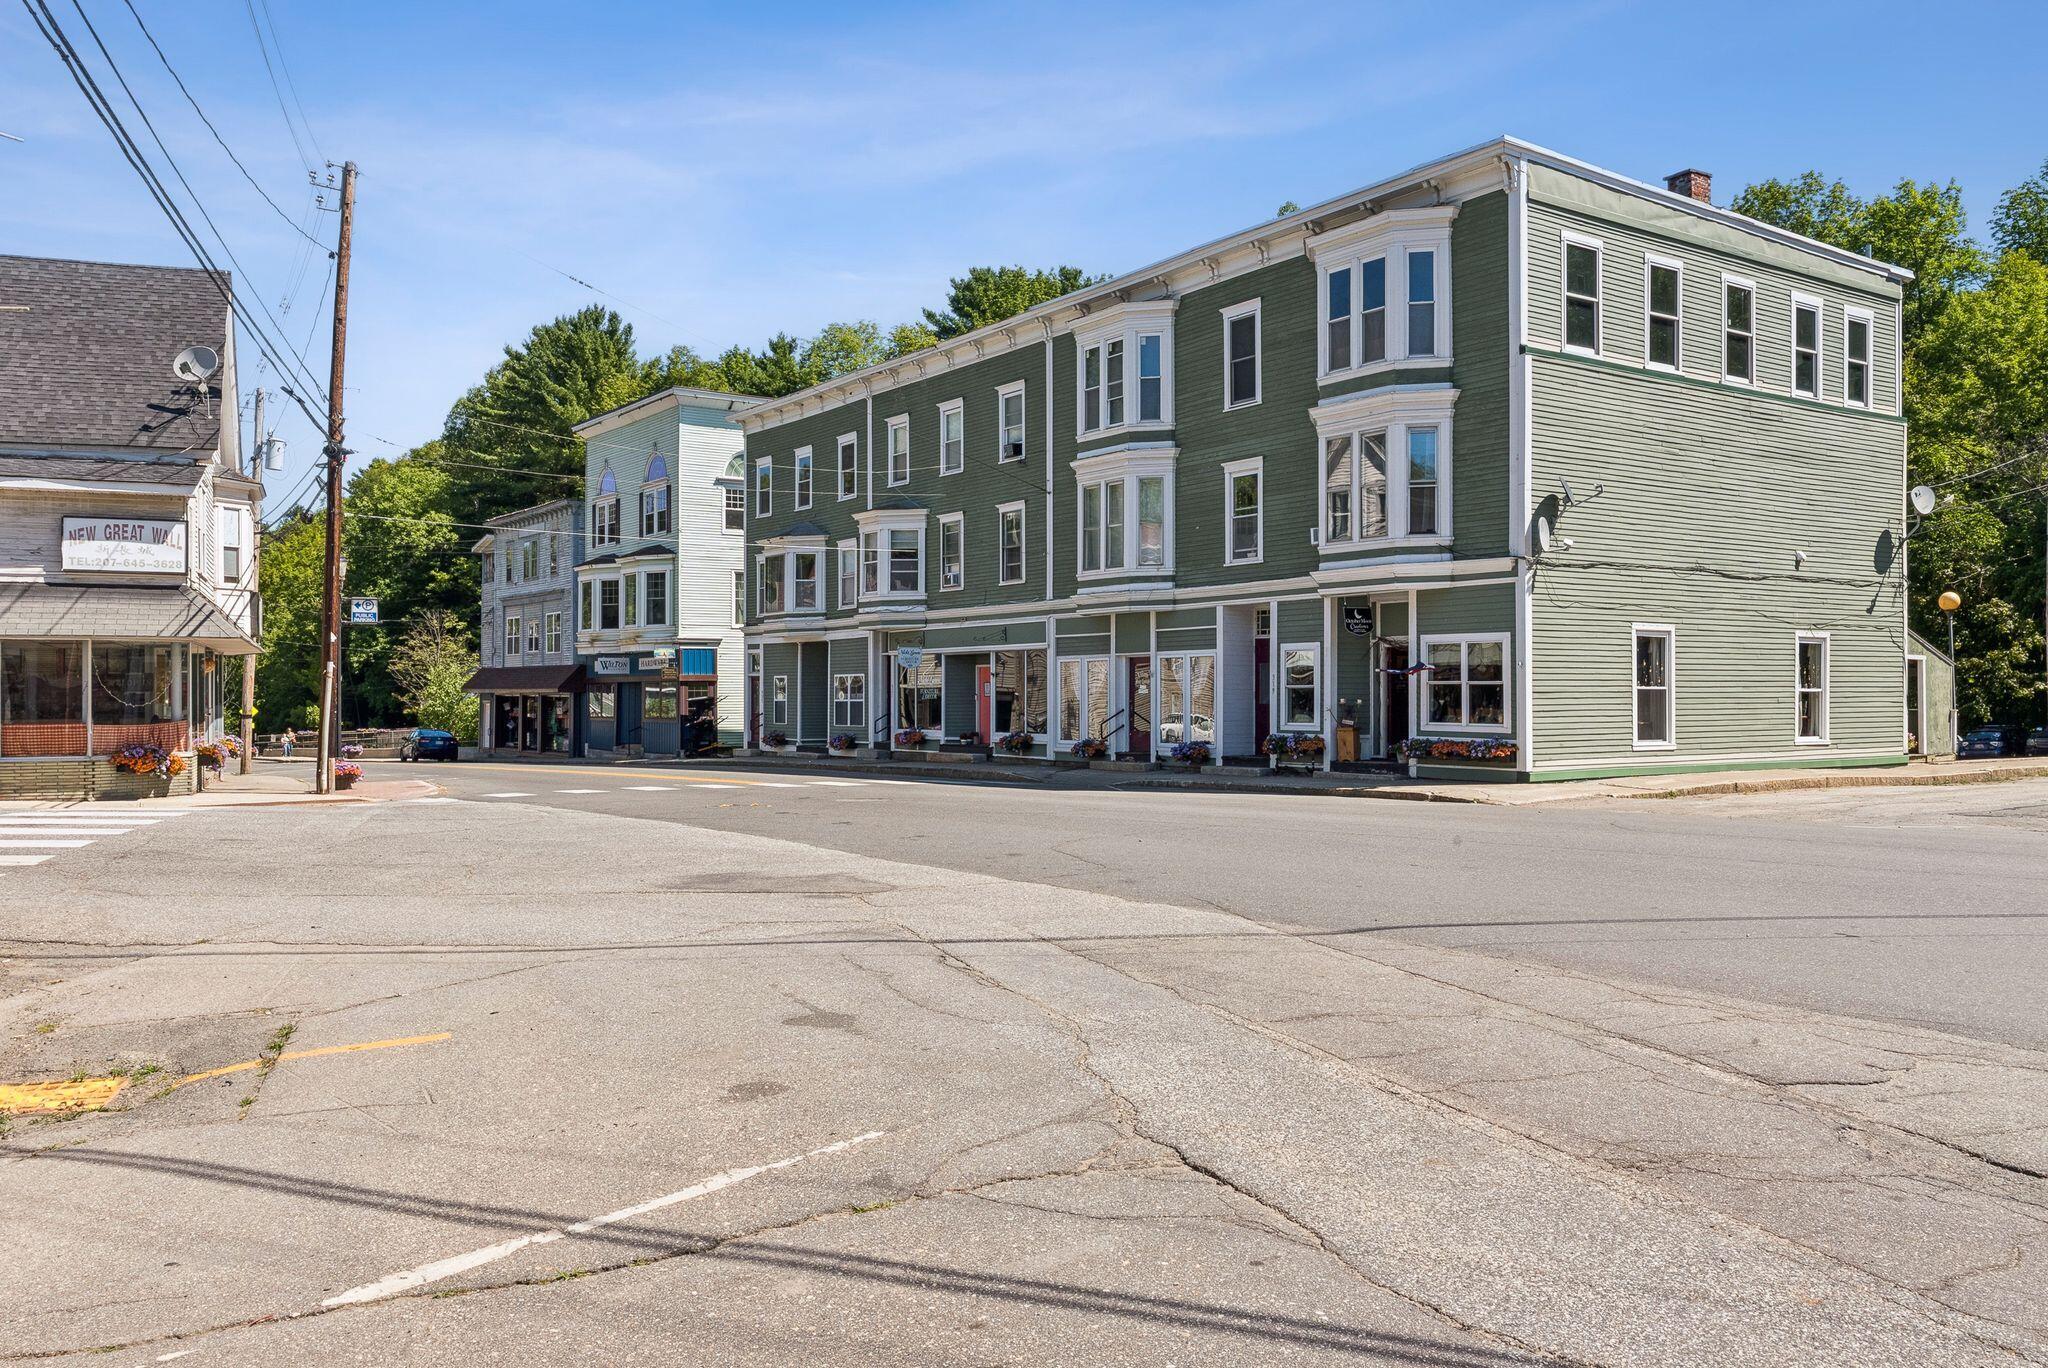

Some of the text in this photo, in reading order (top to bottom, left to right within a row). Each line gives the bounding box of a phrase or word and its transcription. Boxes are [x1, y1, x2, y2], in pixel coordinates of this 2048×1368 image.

[69, 523, 183, 550] NEW GREAT WALL
